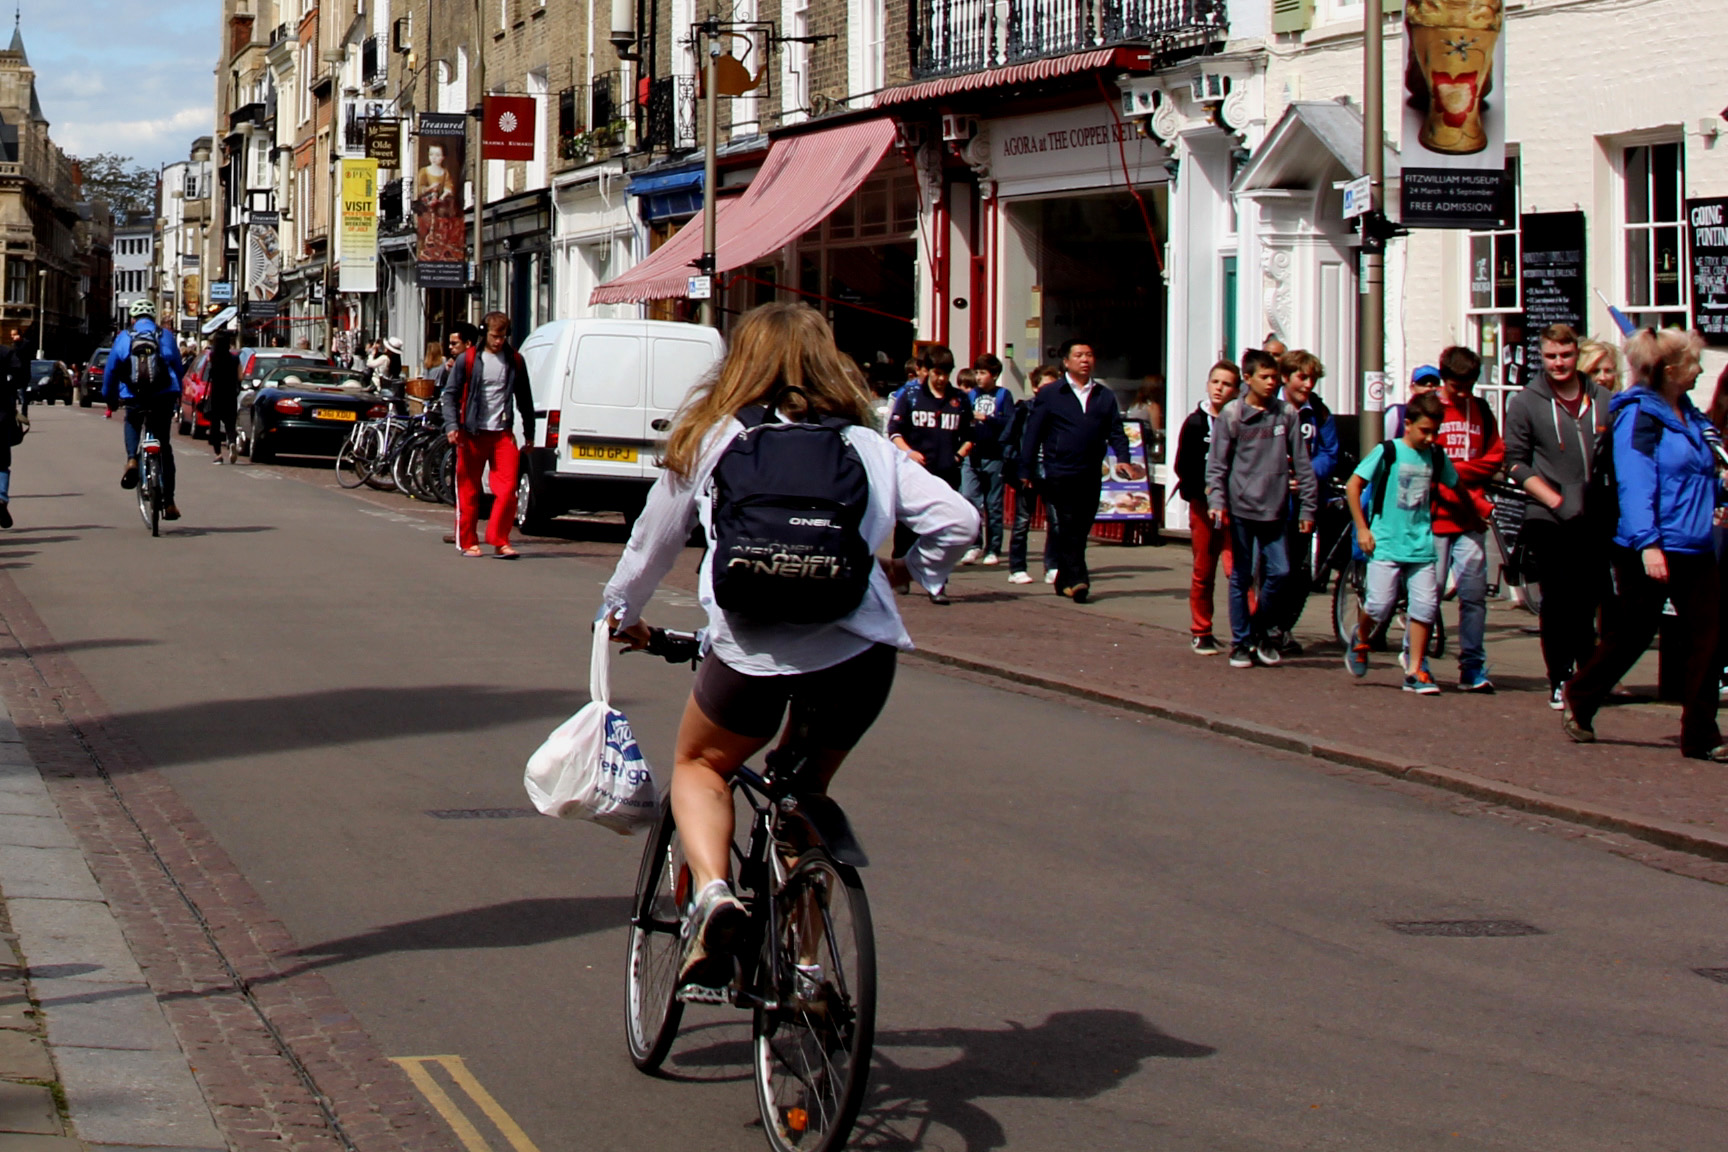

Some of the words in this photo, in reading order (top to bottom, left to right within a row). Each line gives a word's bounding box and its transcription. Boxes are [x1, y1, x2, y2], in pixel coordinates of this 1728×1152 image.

[420, 119, 465, 129] Treasured
[372, 140, 392, 149] Olde
[1004, 137, 1037, 156] AGORA
[1048, 130, 1068, 150] THE
[1071, 125, 1109, 147] COPPER
[370, 149, 394, 158] Sweet
[1405, 174, 1460, 184] FITZWILLIAM
[1462, 176, 1499, 185] MUSEUM
[1409, 186, 1418, 195] 24
[1420, 187, 1442, 195] March
[1456, 188, 1494, 197] September
[345, 201, 372, 211] VISIT
[1410, 201, 1432, 211] FREE
[1435, 202, 1492, 212] ADMISSION
[1691, 204, 1723, 227] GOING
[579, 446, 604, 457] DL10
[607, 447, 630, 460] GPJ
